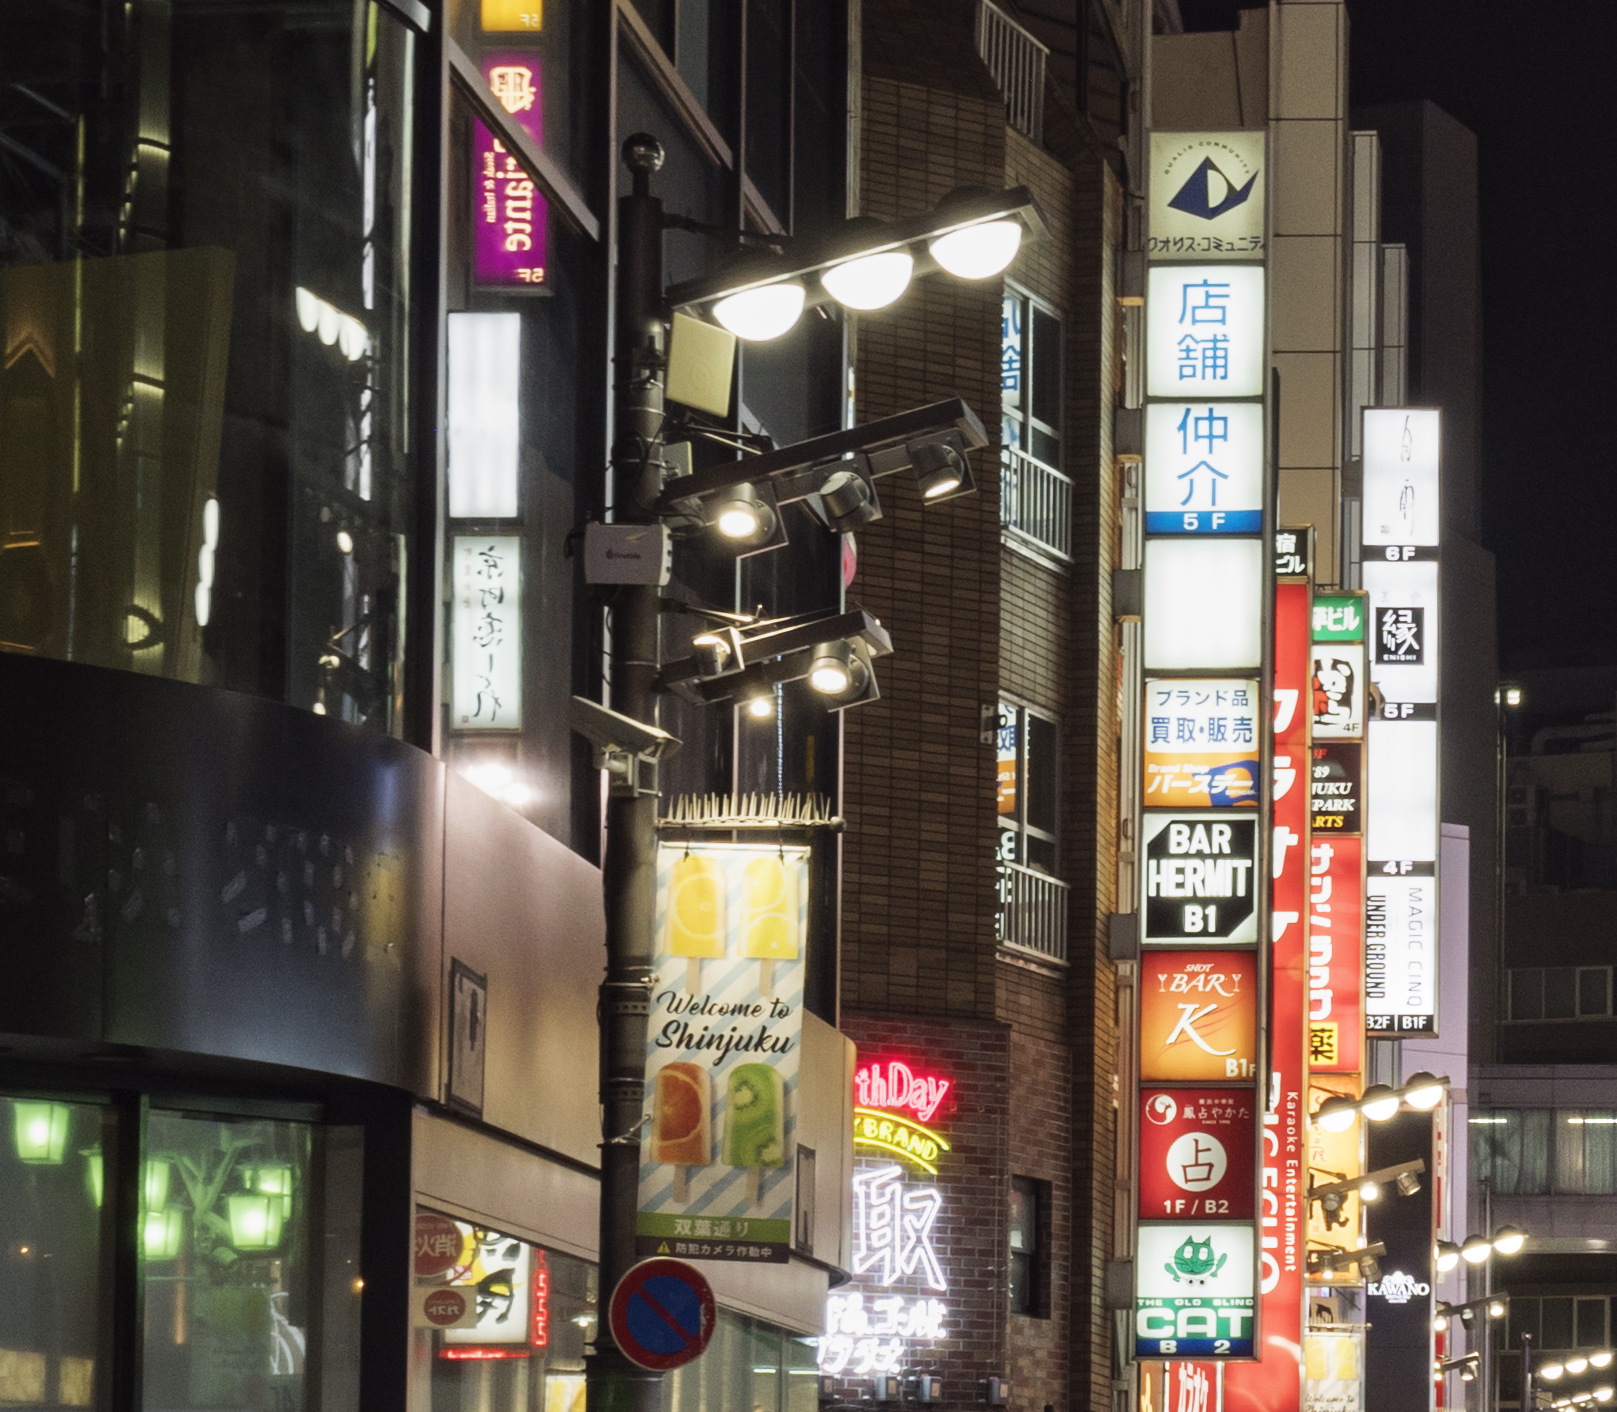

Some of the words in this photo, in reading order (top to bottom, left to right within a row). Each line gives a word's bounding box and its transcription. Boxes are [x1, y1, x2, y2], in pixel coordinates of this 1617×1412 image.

[1177, 279, 1231, 382] 店舗
[1176, 406, 1230, 507] 仲介
[1385, 545, 1416, 561] 6F
[1382, 608, 1420, 655] 縁
[1157, 689, 1249, 708] ブランド品
[1384, 703, 1415, 719] 5F
[1150, 716, 1253, 744] 買取・販売
[1343, 723, 1360, 733] 4F
[1148, 774, 1255, 794] バースデー
[1169, 824, 1231, 855] BAR
[1148, 859, 1252, 898] HERMIT
[1383, 861, 1413, 876] 4F
[1184, 905, 1217, 933] B1
[1366, 894, 1386, 938] UNDER
[1408, 887, 1423, 950] MAGIC
[1184, 963, 1215, 973] SHOT
[1366, 942, 1386, 999] GROUND
[1169, 973, 1235, 997] BAR
[1406, 961, 1423, 1007] CINQ
[656, 990, 764, 1019] Welcome
[765, 996, 794, 1019] to
[1166, 1002, 1236, 1056] K
[1402, 1015, 1428, 1030] B1F
[655, 1019, 795, 1067] Shinjuku
[1286, 1091, 1298, 1154] Karaoke
[863, 1117, 939, 1163] BRAND
[1181, 1138, 1215, 1185] 占
[1164, 1200, 1186, 1214] 1F
[1204, 1200, 1229, 1214] B2
[1284, 1159, 1299, 1272] Entertainment
[674, 1218, 750, 1238] 双葉通り
[675, 1242, 773, 1258] 防犯カメラ作動中
[1137, 1299, 1163, 1307] THE
[1174, 1299, 1202, 1307] OLD
[1212, 1299, 1254, 1307] BLIND
[1366, 1282, 1430, 1297] KAWANO
[1136, 1307, 1254, 1338] CAT
